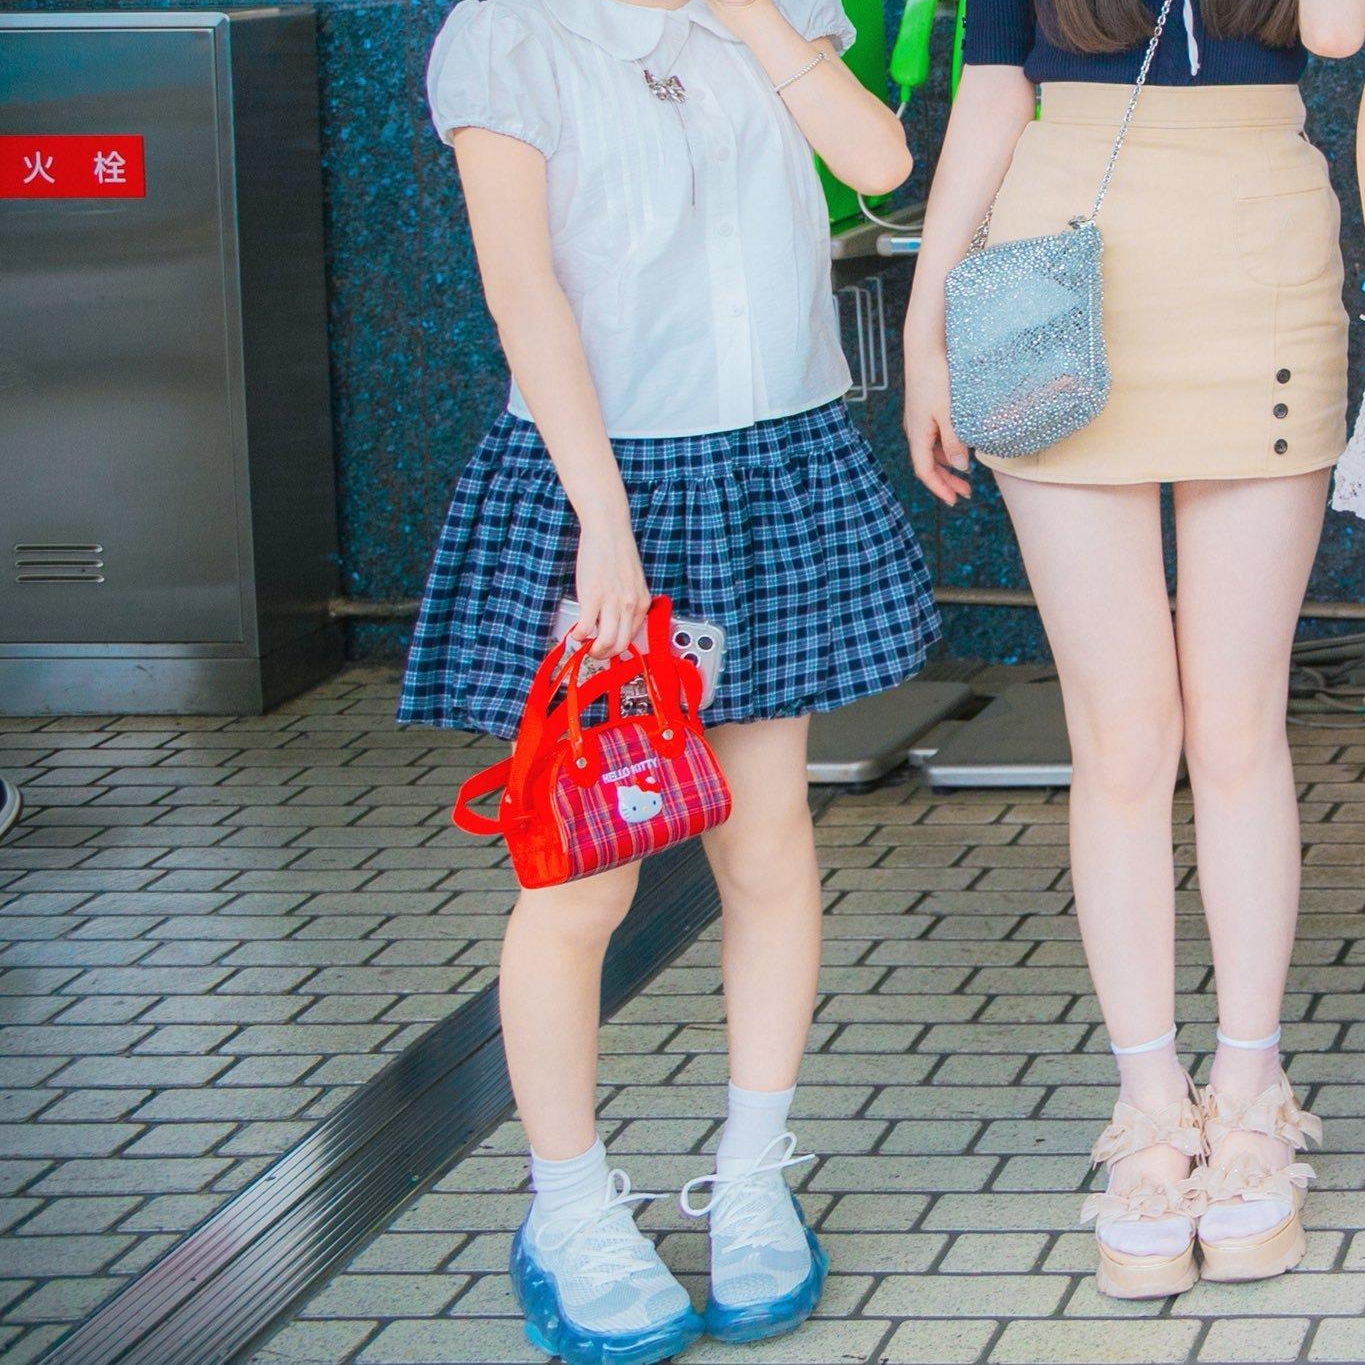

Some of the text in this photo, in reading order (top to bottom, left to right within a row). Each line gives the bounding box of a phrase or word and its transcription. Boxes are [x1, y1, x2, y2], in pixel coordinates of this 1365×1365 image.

[22, 150, 128, 186] 火栓
[602, 756, 658, 784] HELLO KITTY
